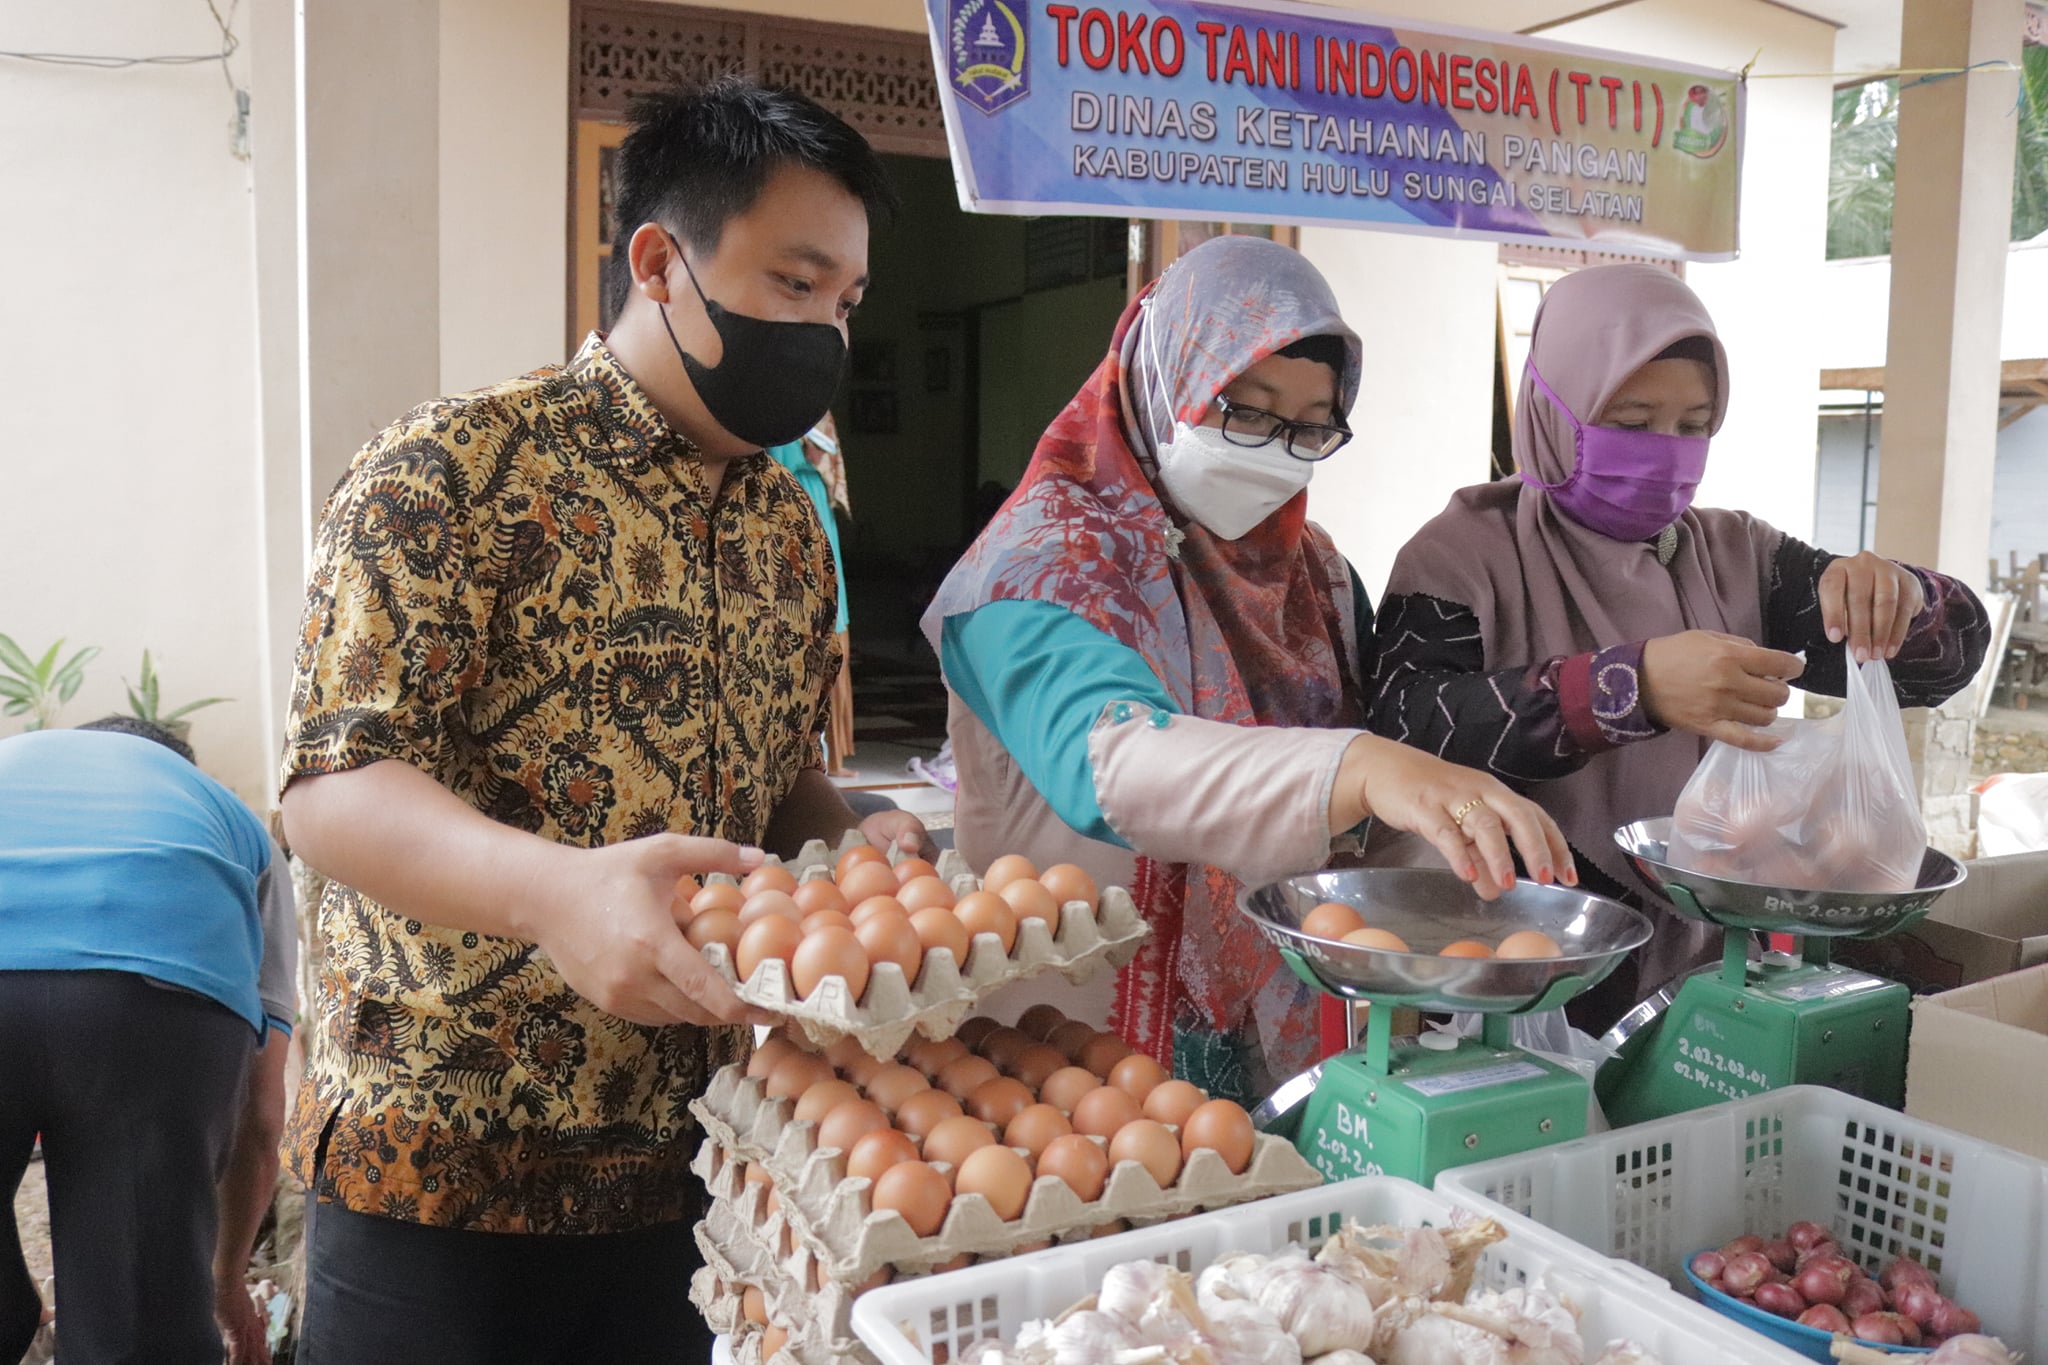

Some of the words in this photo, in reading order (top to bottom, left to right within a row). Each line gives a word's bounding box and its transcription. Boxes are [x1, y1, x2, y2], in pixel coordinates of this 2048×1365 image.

[1047, 5, 1184, 76] TOKO
[1197, 22, 1299, 89] TANI
[1315, 36, 1538, 119] INDONESIA
[1071, 91, 1217, 141] DINAS
[1237, 105, 1486, 165] KETAHANAN
[1505, 136, 1647, 184] PANGAN
[1074, 146, 1288, 189] KABUPATEN
[1303, 163, 1390, 197] HULU
[1404, 171, 1516, 208] SUNGAI
[1529, 186, 1643, 222] SELATAN
